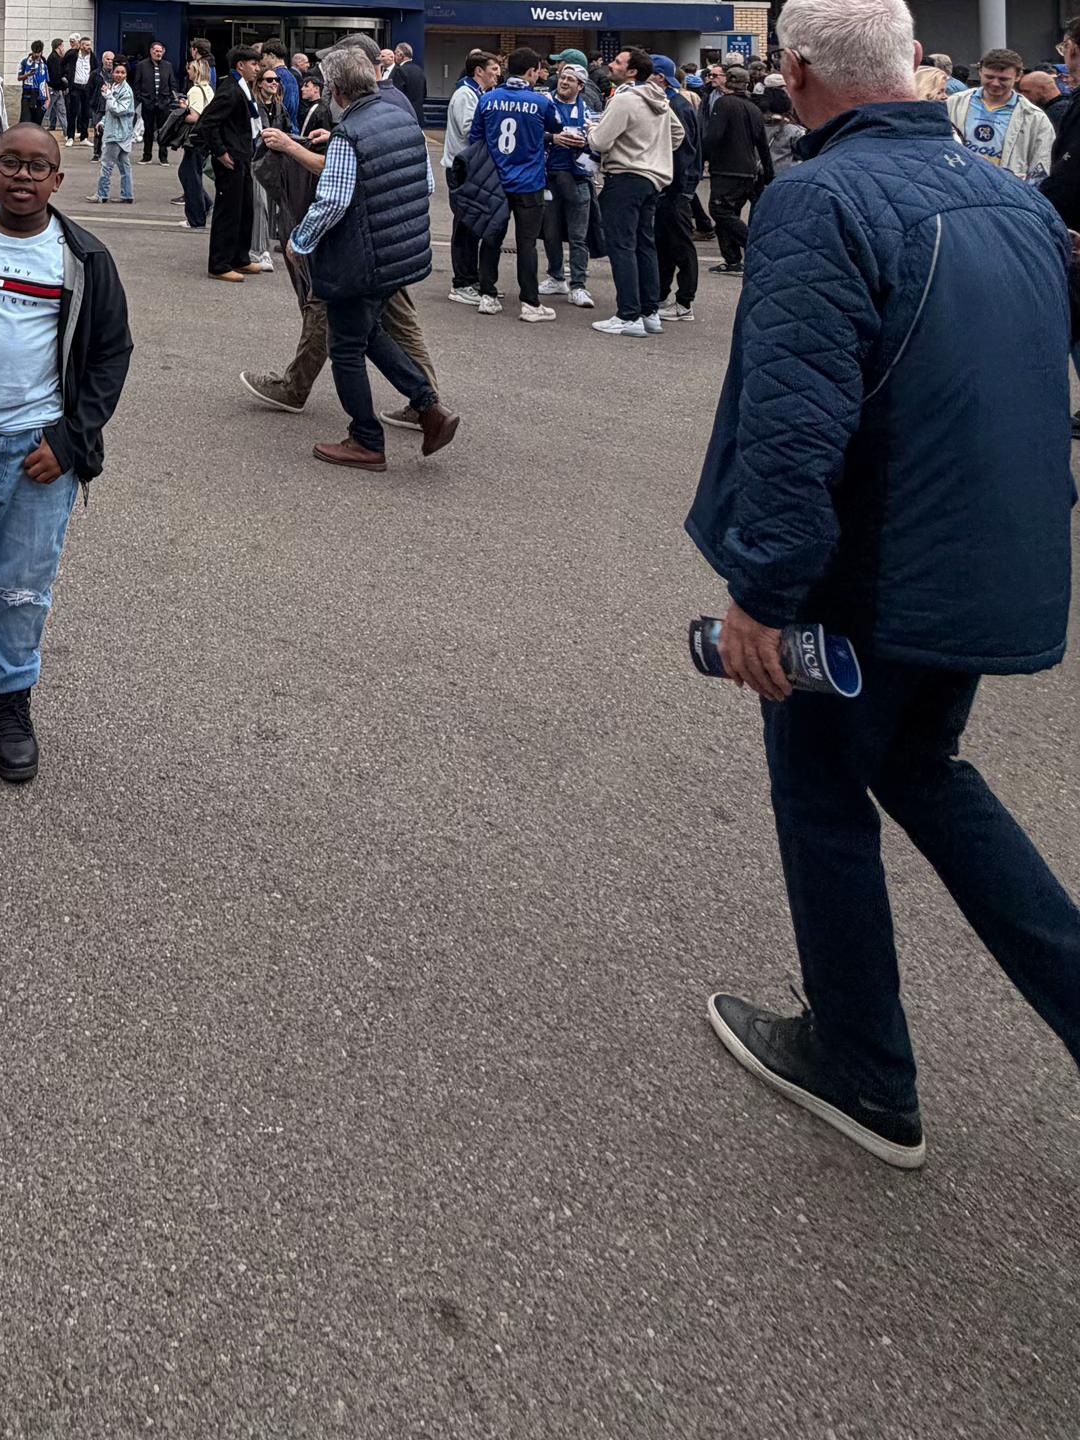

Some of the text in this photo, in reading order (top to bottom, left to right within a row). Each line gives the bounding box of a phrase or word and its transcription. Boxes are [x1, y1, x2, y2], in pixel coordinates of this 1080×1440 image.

[531, 7, 603, 21] Westview
[486, 99, 538, 115] LAMPARD
[498, 117, 517, 155] 8
